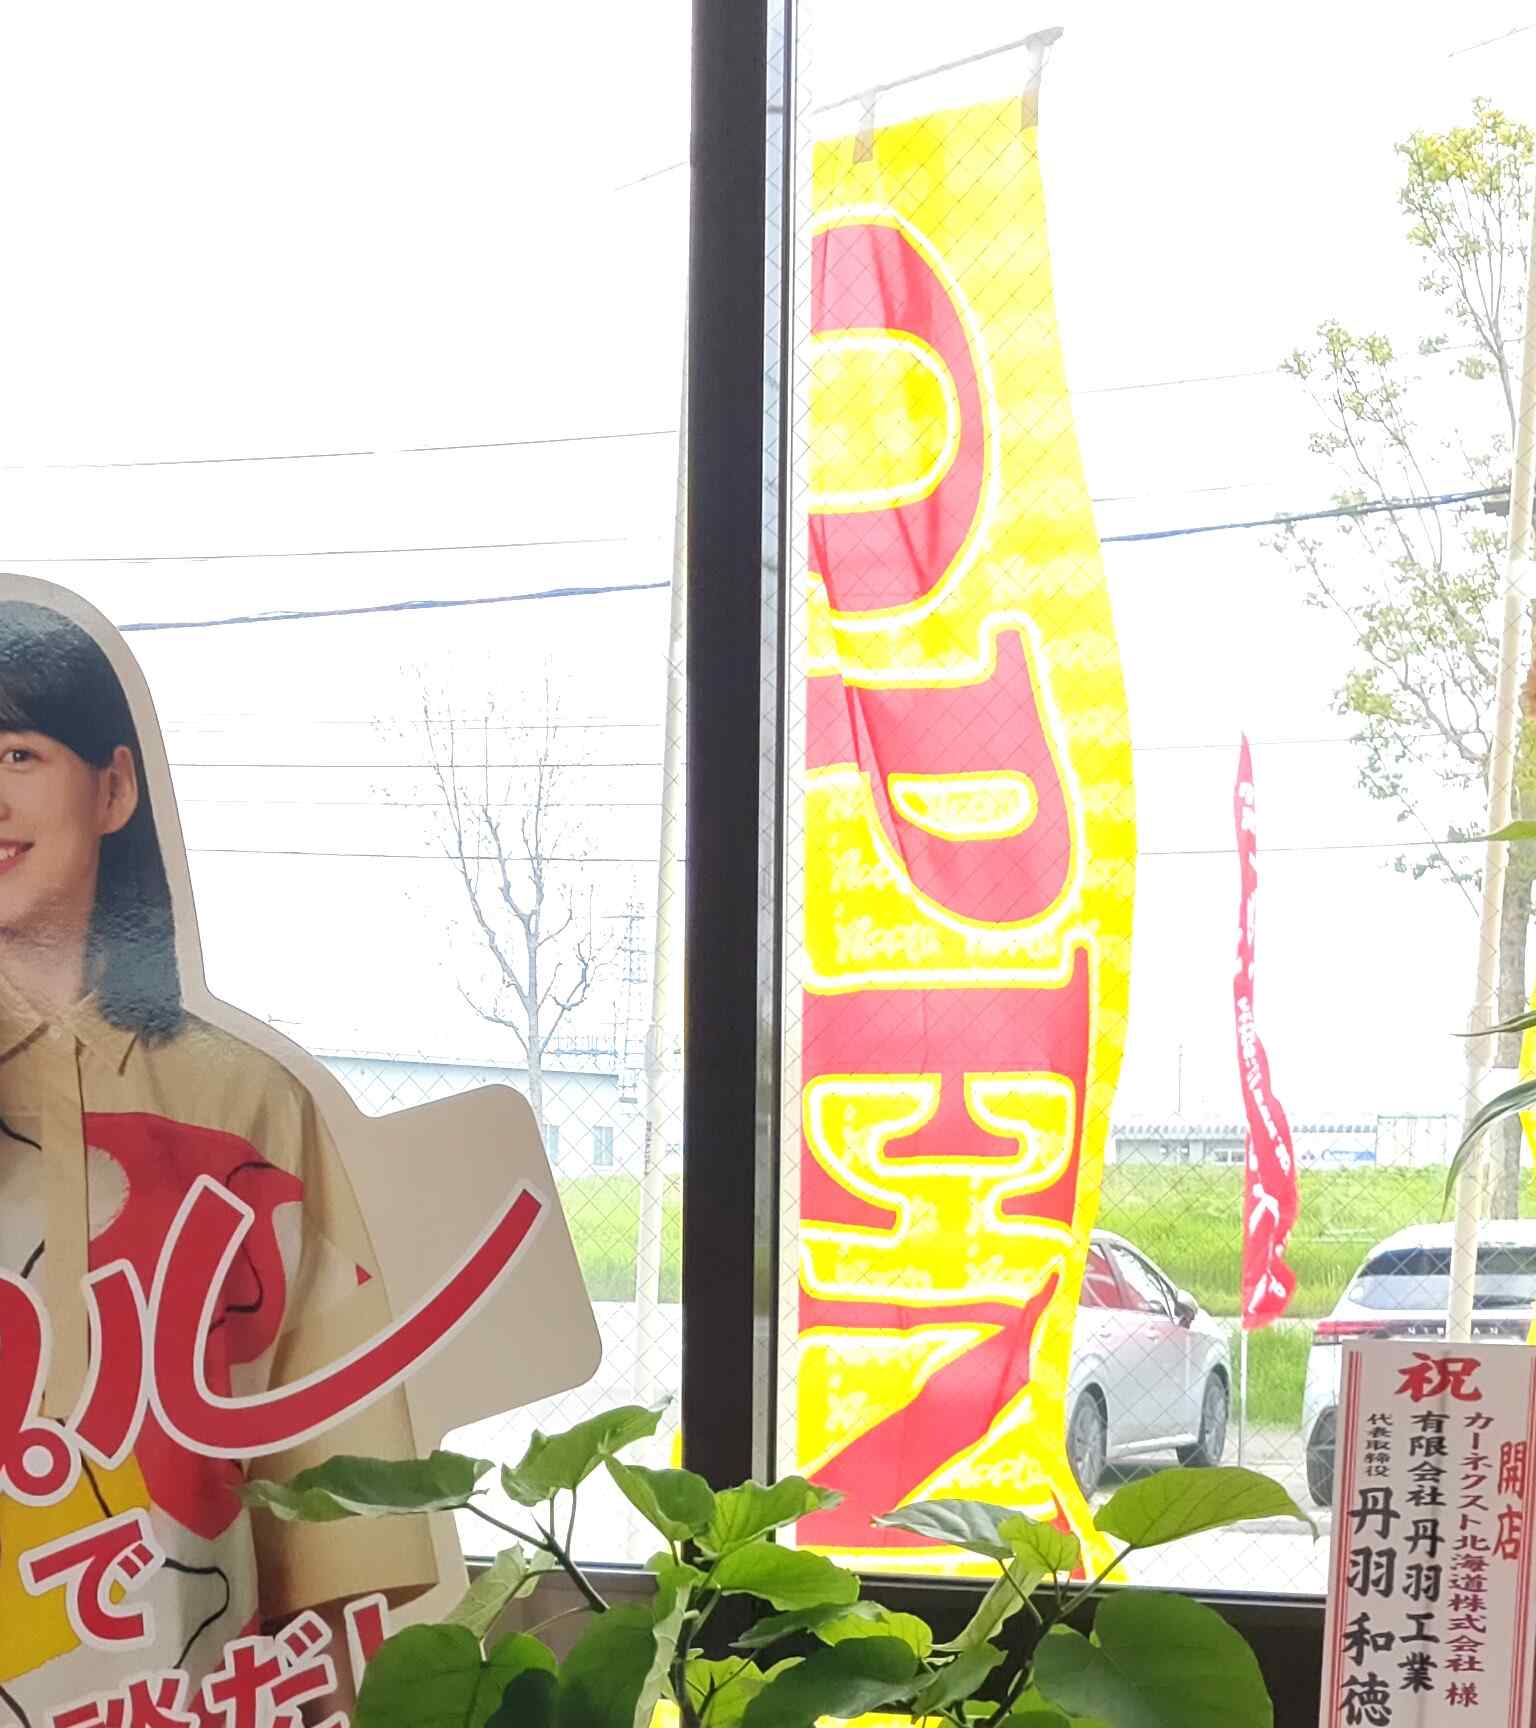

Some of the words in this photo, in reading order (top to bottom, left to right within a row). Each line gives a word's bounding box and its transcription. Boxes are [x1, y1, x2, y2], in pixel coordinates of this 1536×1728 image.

[1408, 1327, 1499, 1337] NISAN
[1394, 1352, 1483, 1402] 祝
[1493, 1440, 1527, 1561] 開店
[30, 1512, 166, 1647] で
